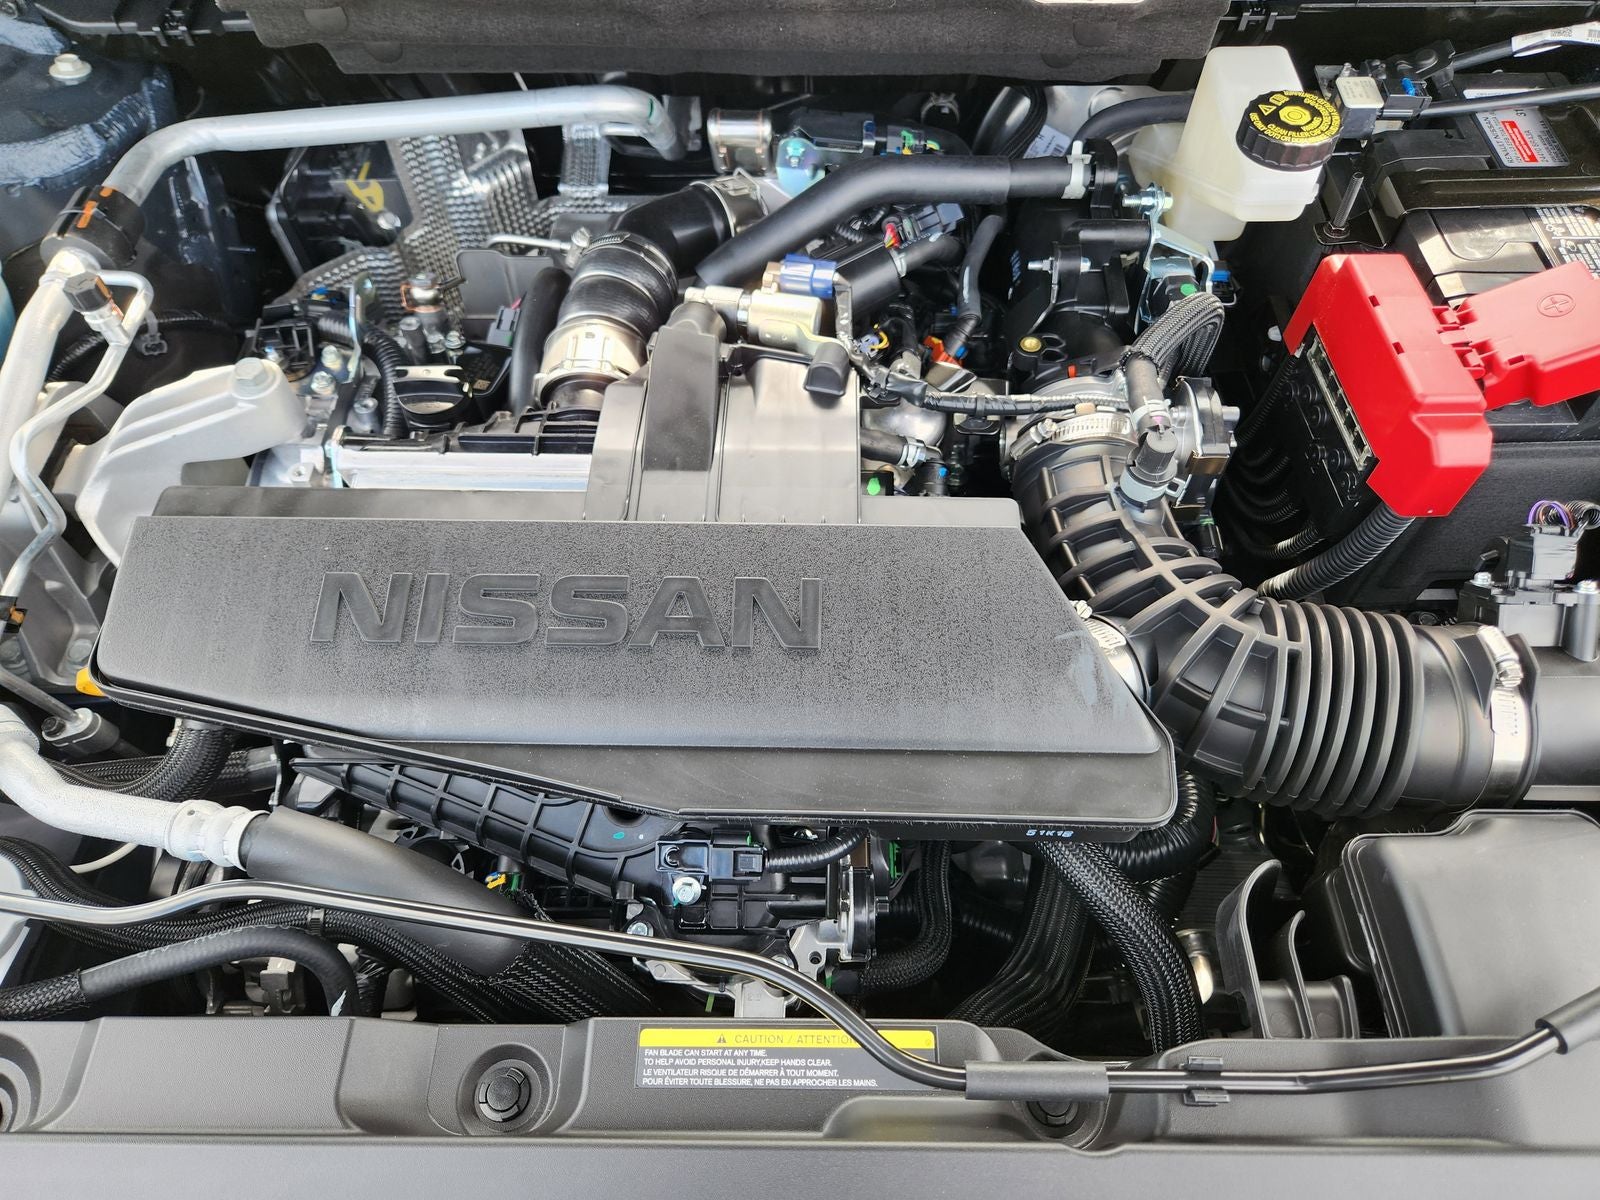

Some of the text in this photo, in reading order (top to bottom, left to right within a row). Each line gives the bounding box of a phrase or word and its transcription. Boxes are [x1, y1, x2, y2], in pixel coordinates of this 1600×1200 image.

[1268, 124, 1288, 136] CLEAN
[310, 571, 823, 650] NISSAN
[734, 1034, 784, 1044] CAUTION
[644, 1058, 654, 1066] TO
[655, 1058, 674, 1066] HELP
[674, 1058, 696, 1066] AVOID
[698, 1058, 736, 1066] PERSONAL
[643, 1068, 652, 1076] LE
[653, 1068, 698, 1076] VENTILATEUR
[700, 1068, 726, 1076] RISQUE
[740, 1067, 778, 1076] DÉMARRER
[780, 1067, 786, 1076] À
[714, 1078, 752, 1086] BLESSURE,
[754, 1078, 764, 1086] NE
[766, 1078, 780, 1086] PAS
[781, 1078, 791, 1086] EN
[792, 1078, 838, 1086] APPROCHER
